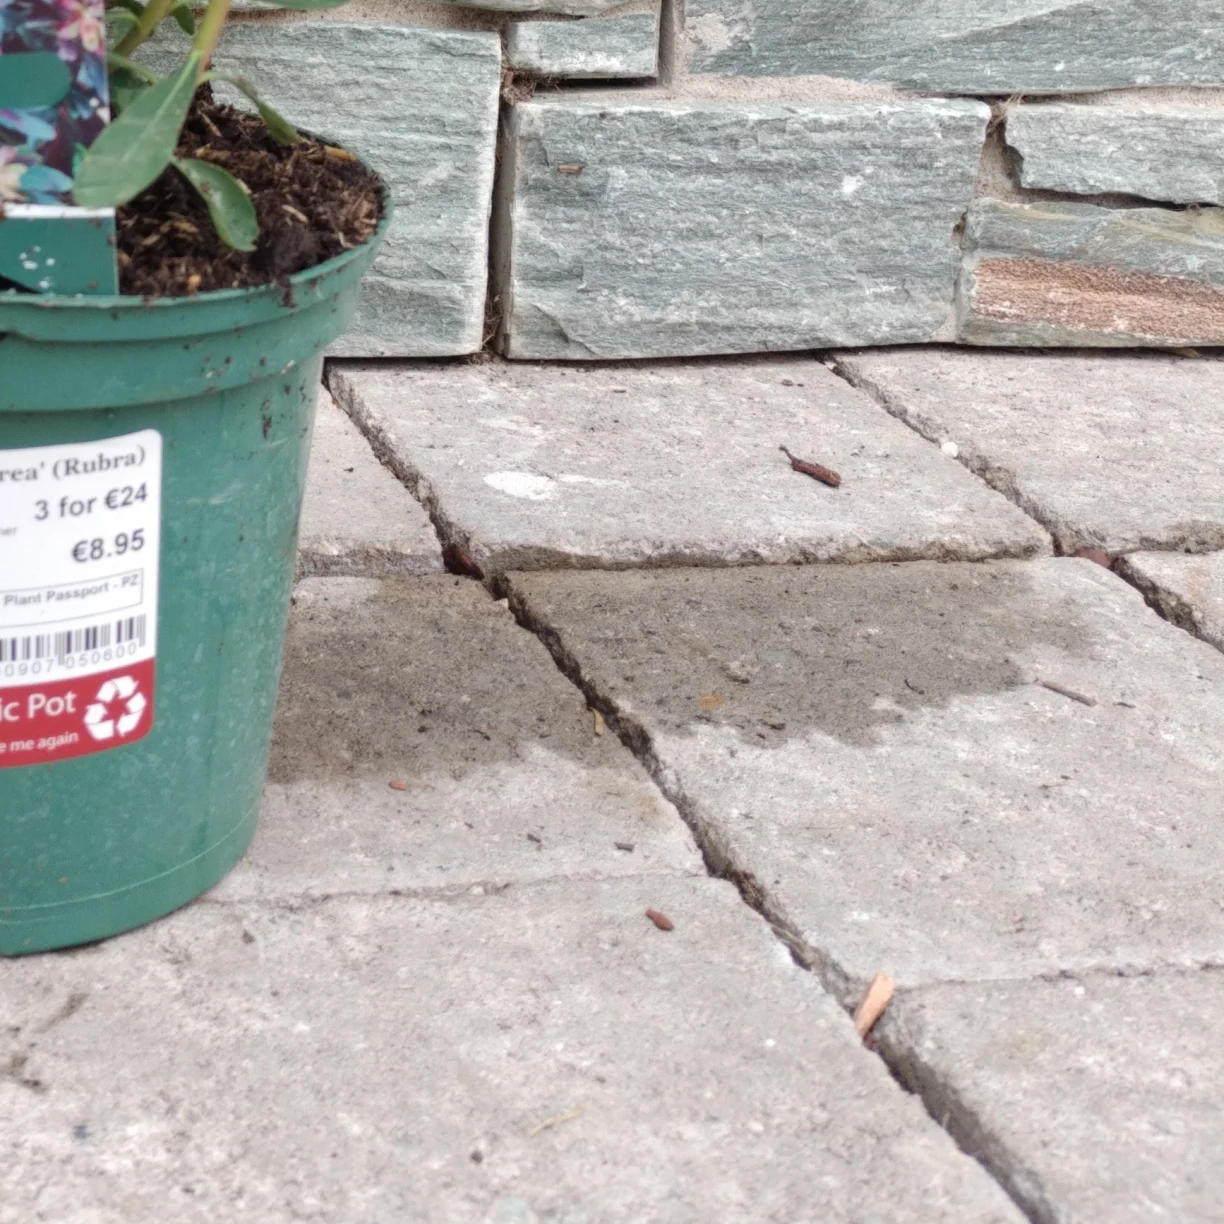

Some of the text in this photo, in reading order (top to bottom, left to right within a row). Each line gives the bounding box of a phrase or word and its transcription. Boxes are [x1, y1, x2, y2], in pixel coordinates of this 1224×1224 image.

[52, 445, 146, 480] (Rubra)
[34, 481, 148, 521] 3 for €24
[71, 528, 145, 563] €8.95
[3, 592, 42, 607] Plant
[46, 581, 109, 602] Passport
[28, 690, 77, 719] Pot
[10, 739, 35, 753] me
[37, 731, 79, 751] again
